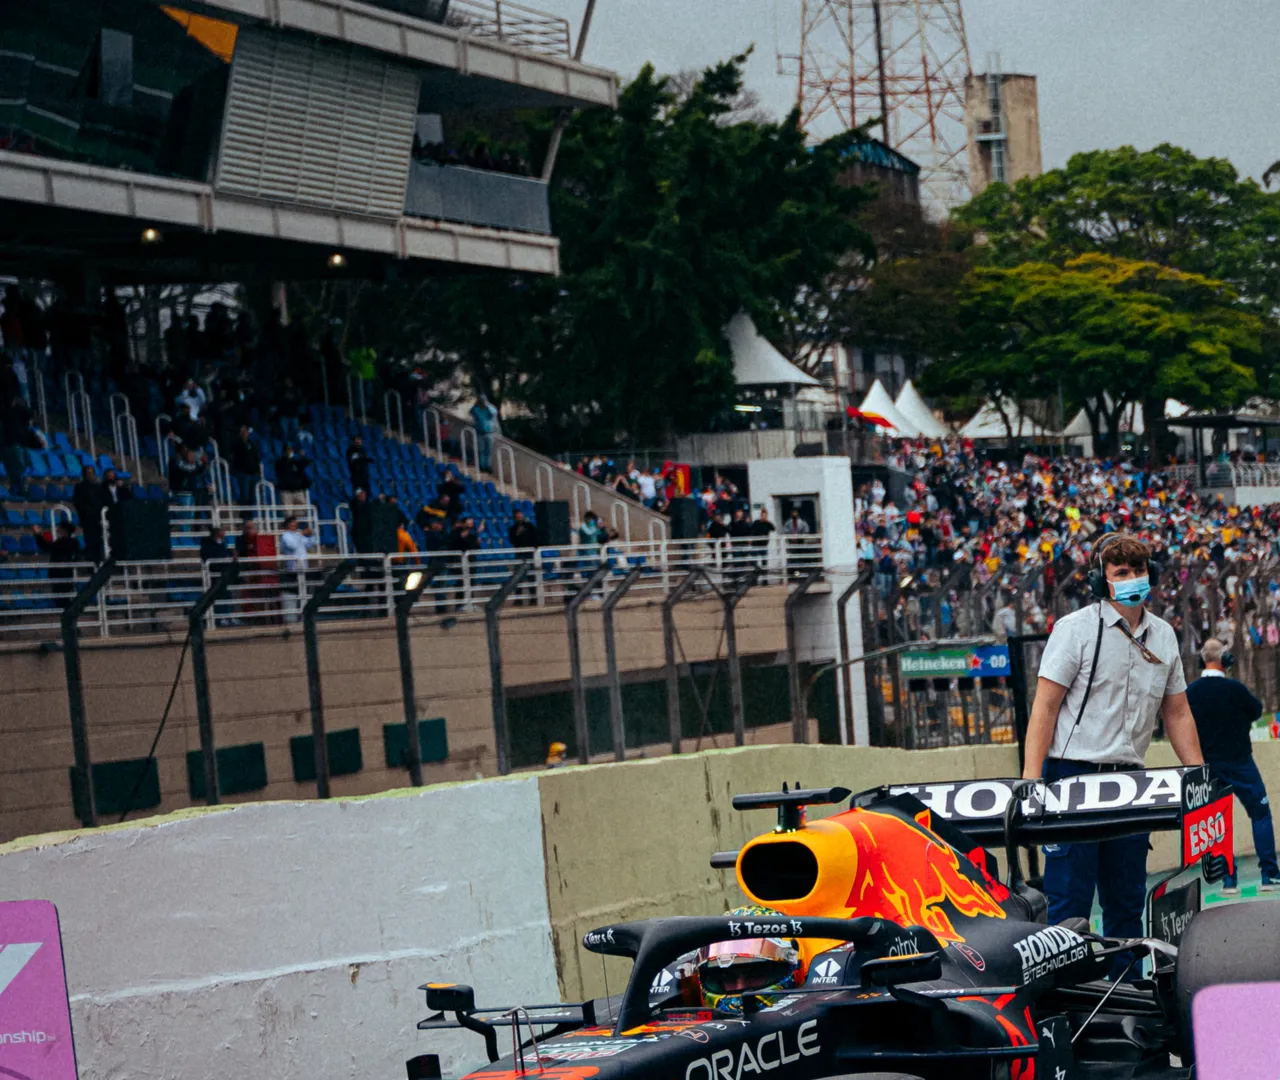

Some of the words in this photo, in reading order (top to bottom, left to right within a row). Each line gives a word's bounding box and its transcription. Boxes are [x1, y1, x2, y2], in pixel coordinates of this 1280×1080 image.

[901, 656, 966, 672] Heineken
[890, 769, 1183, 820] HONDA
[1190, 812, 1226, 857] ESSO
[745, 922, 788, 935] Tezos
[1013, 924, 1086, 970] HONDA
[812, 976, 838, 985] INTER
[649, 985, 671, 994] NTER
